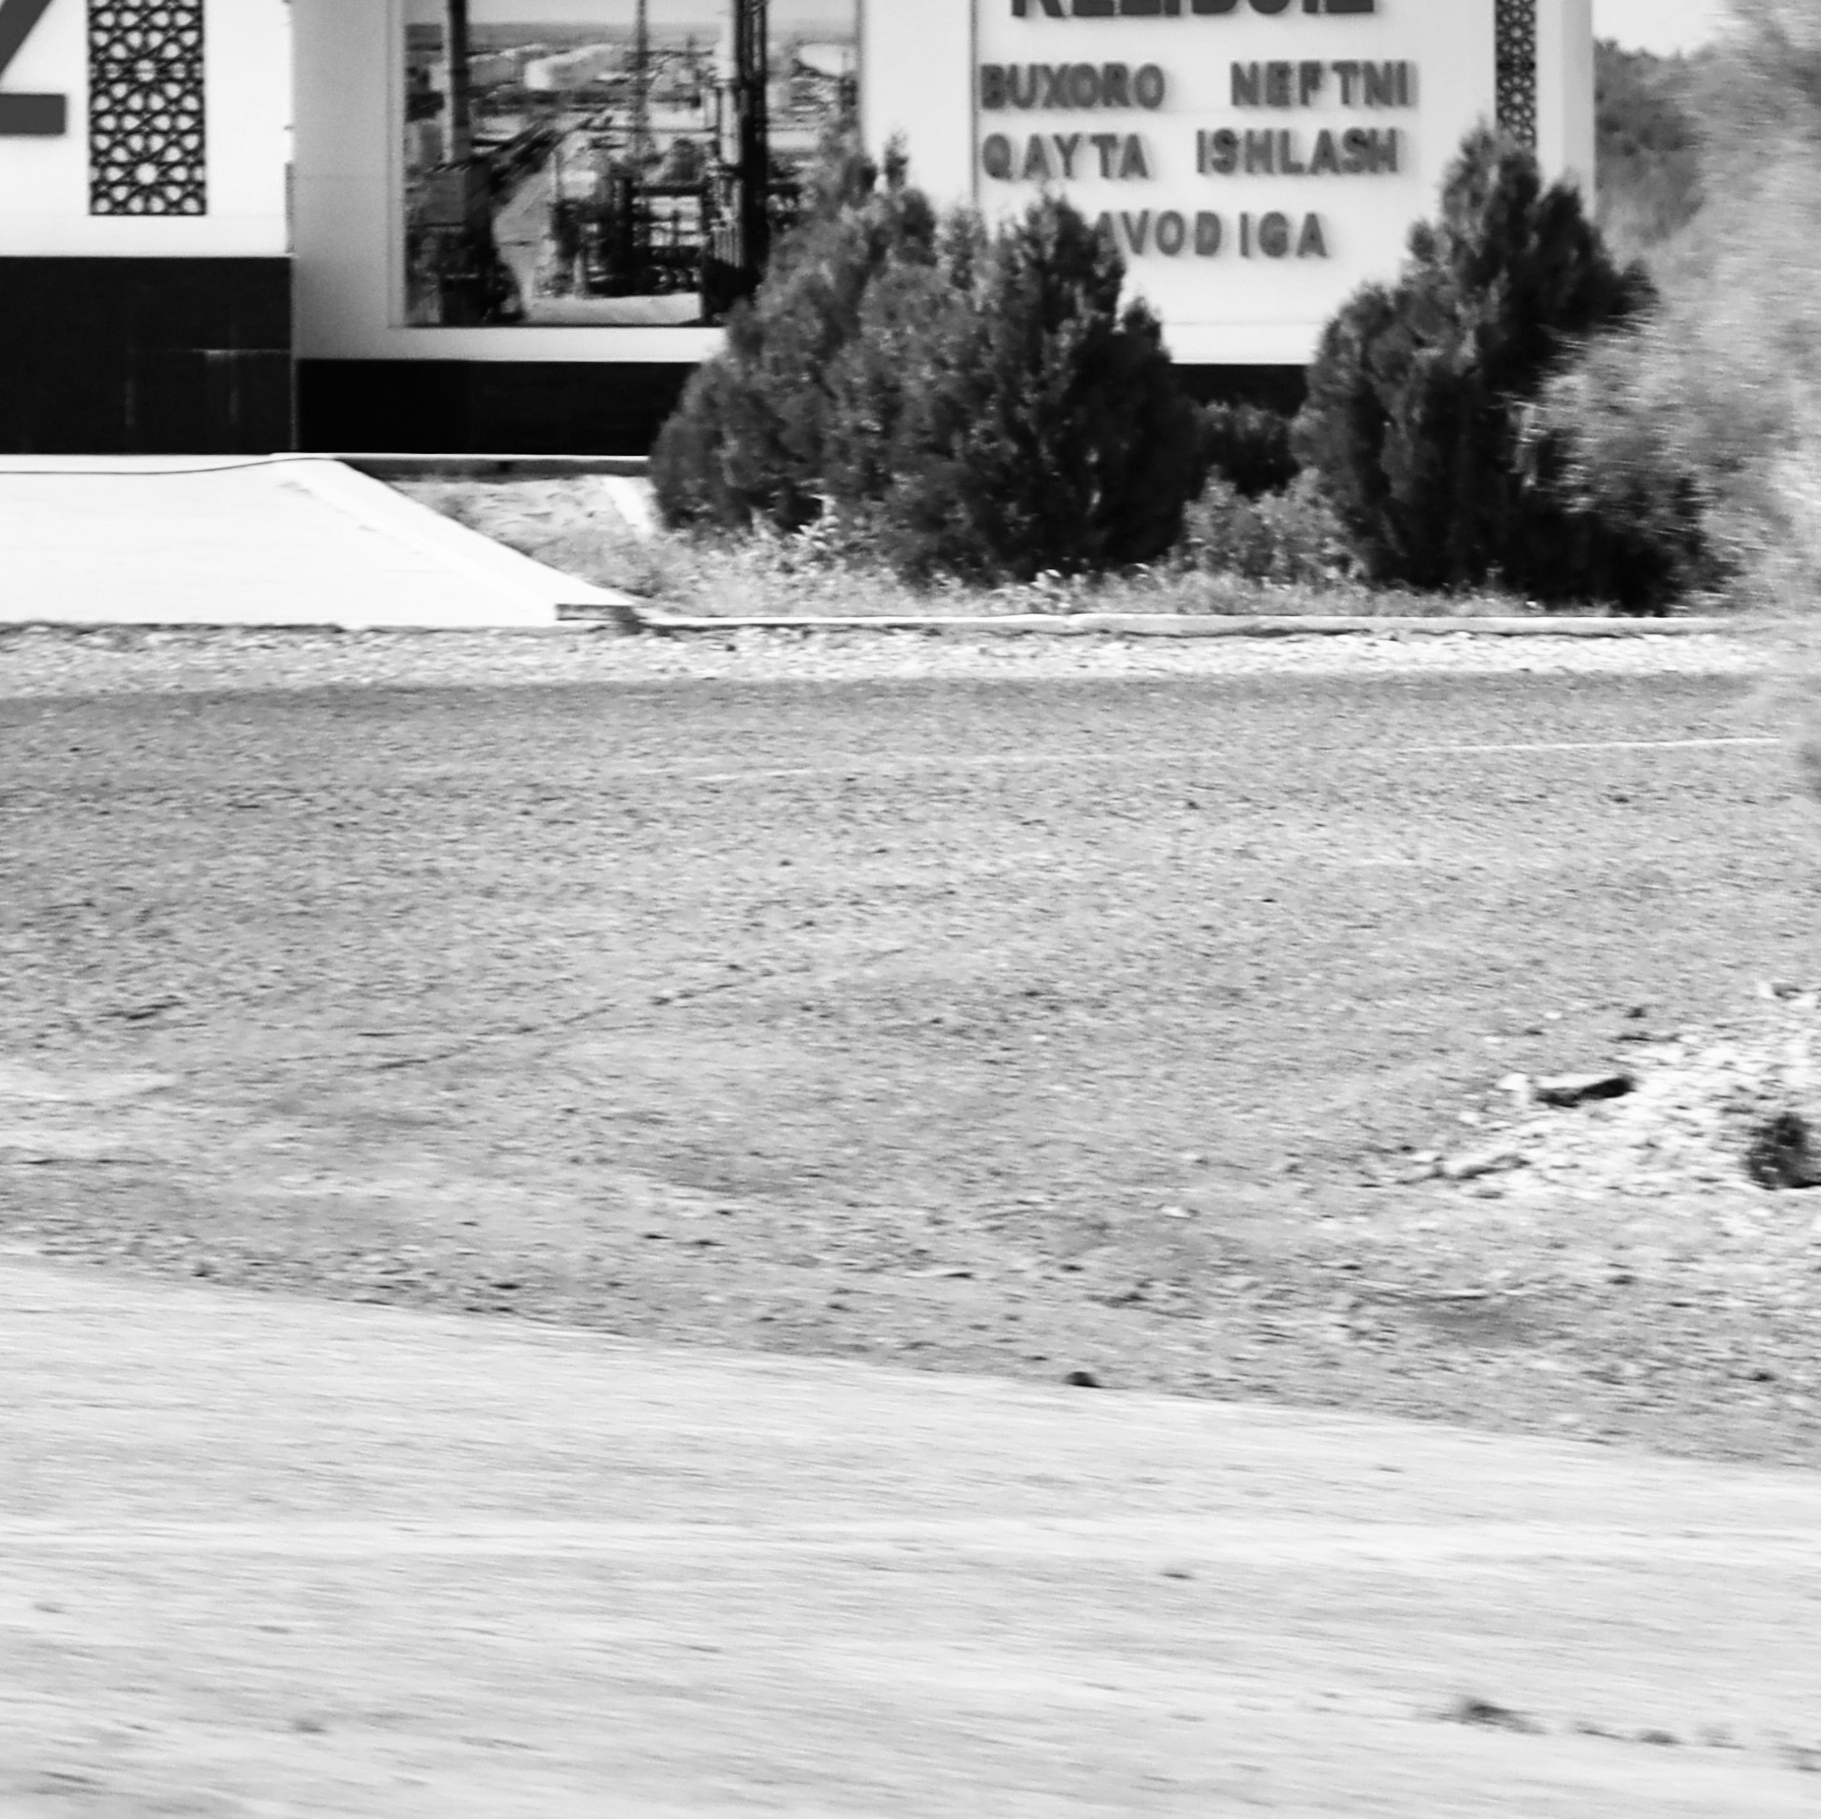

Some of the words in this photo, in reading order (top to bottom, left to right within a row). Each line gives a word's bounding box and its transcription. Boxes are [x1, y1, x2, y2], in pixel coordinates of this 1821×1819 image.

[981, 63, 1165, 109] BUXORO
[1231, 61, 1409, 107] NEFTNI
[982, 133, 1149, 179] QAYTA
[1197, 128, 1397, 175] ISHLASH
[1093, 209, 1329, 259] AVODIGA
